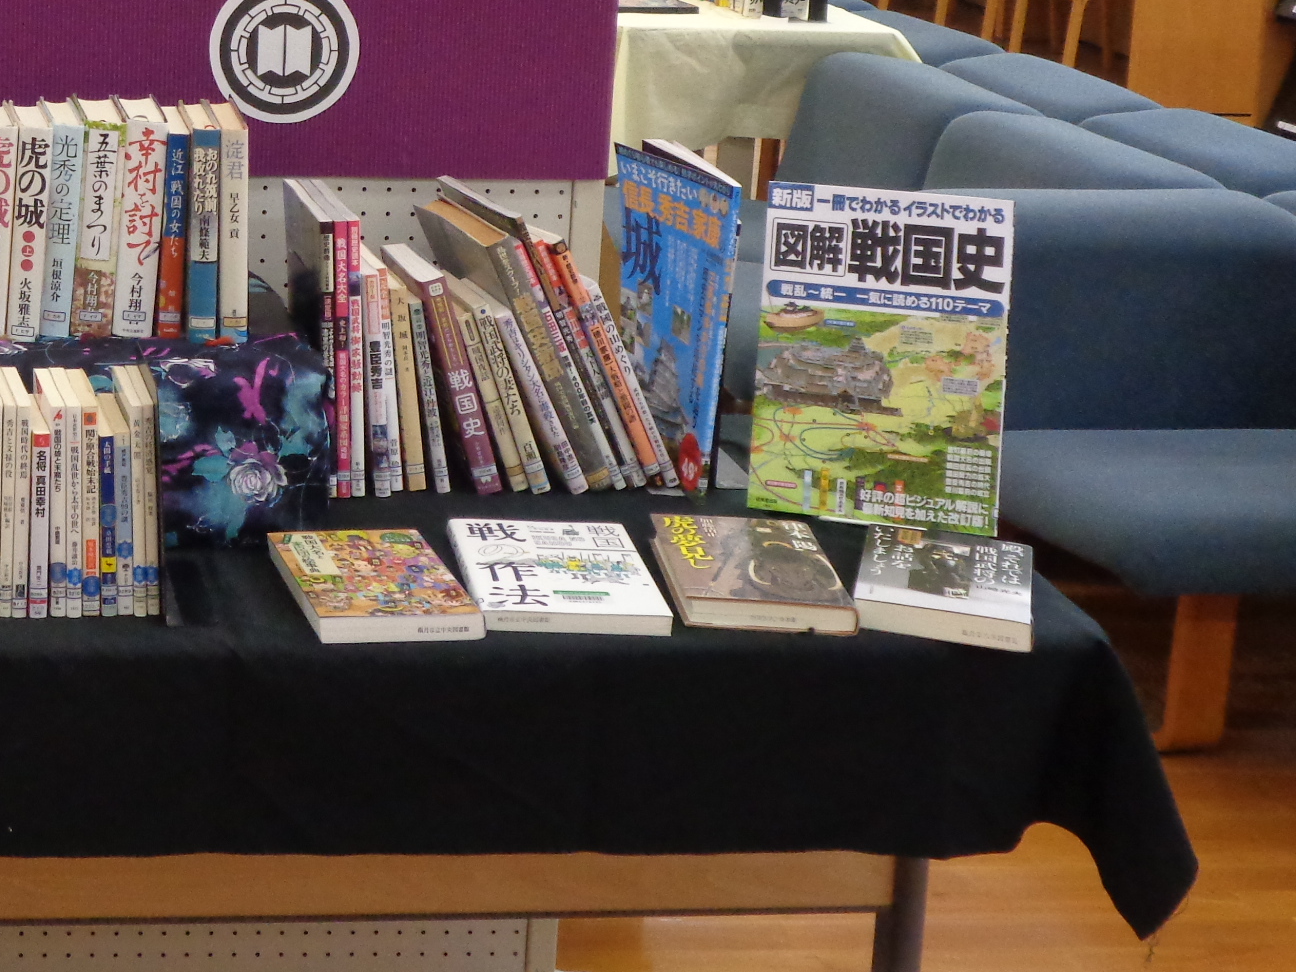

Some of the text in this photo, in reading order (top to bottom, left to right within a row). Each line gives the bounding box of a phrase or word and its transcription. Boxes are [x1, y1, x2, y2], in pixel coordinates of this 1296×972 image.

[15, 136, 50, 230] 虎の城
[225, 139, 245, 181] 淀君
[619, 160, 698, 201] いまこそ行きたい
[47, 134, 78, 245] 光秀の定理
[85, 132, 117, 258] 五葉のまつり
[124, 126, 168, 267] 幸村を討て
[229, 192, 240, 239] 早乙女貢
[771, 186, 1006, 226] 新版 一冊でわかる イラストでわかる
[335, 238, 348, 303] 戦国大名大全
[621, 206, 663, 297] 城
[775, 217, 1006, 296] 図解 戦国史
[17, 277, 33, 327] 火坂雅志
[50, 258, 63, 303] 垣根涼介
[128, 272, 144, 314] 今村翔
[856, 291, 992, 315] 一気に読める110テーマ
[368, 340, 383, 390] 豊臣秀吉
[381, 321, 394, 376] 明智光秀の謎
[447, 368, 485, 439] 戦国史
[5, 419, 14, 478] 秀吉と文禄の役
[36, 450, 47, 472] 名将
[70, 446, 80, 534] 戦国乱世から太平の世へ
[858, 489, 990, 516] 好評の超ビジュアル解説に
[586, 524, 625, 549] 戦国
[663, 515, 715, 570] 虎の夢見し
[466, 522, 551, 608] 戦の作法
[973, 545, 999, 586] 戦国武将の
